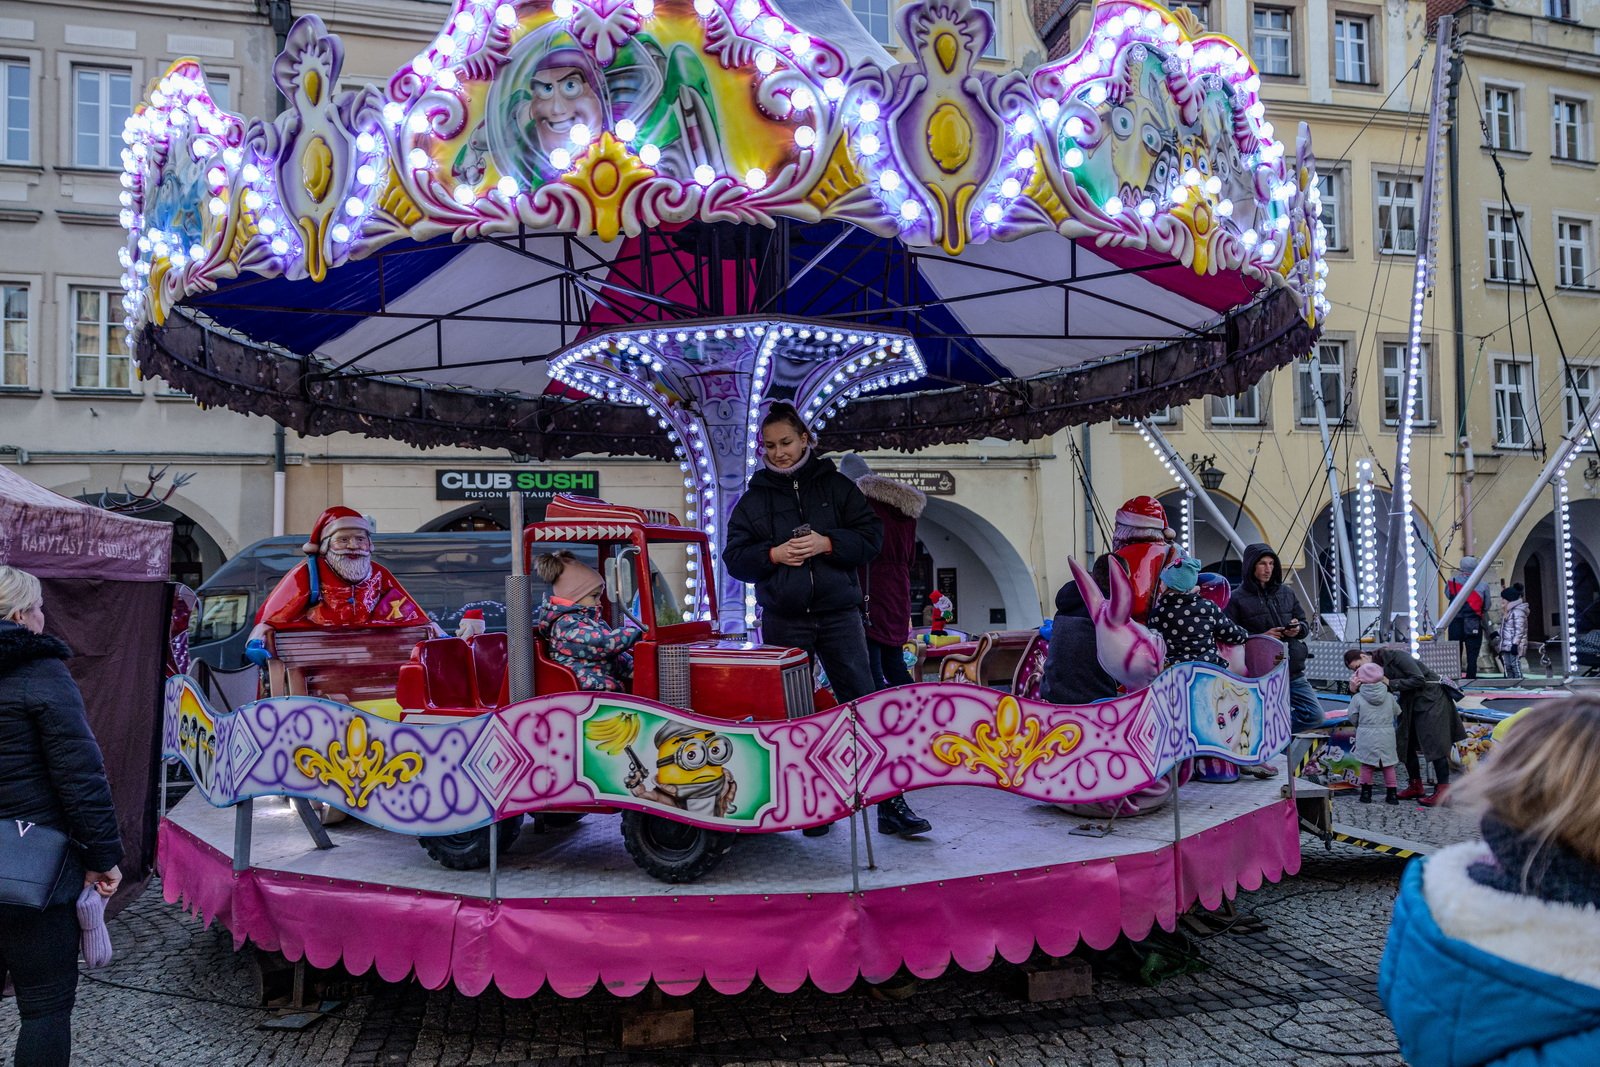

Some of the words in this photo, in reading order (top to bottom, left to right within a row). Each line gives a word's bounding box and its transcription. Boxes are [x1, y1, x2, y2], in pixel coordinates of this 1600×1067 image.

[441, 472, 512, 489] CLUB
[517, 473, 594, 489] SUSHI
[21, 534, 83, 555] RARYTASY
[87, 539, 95, 556] Z
[97, 540, 141, 561] PODLASIA
[15, 819, 36, 837] V
